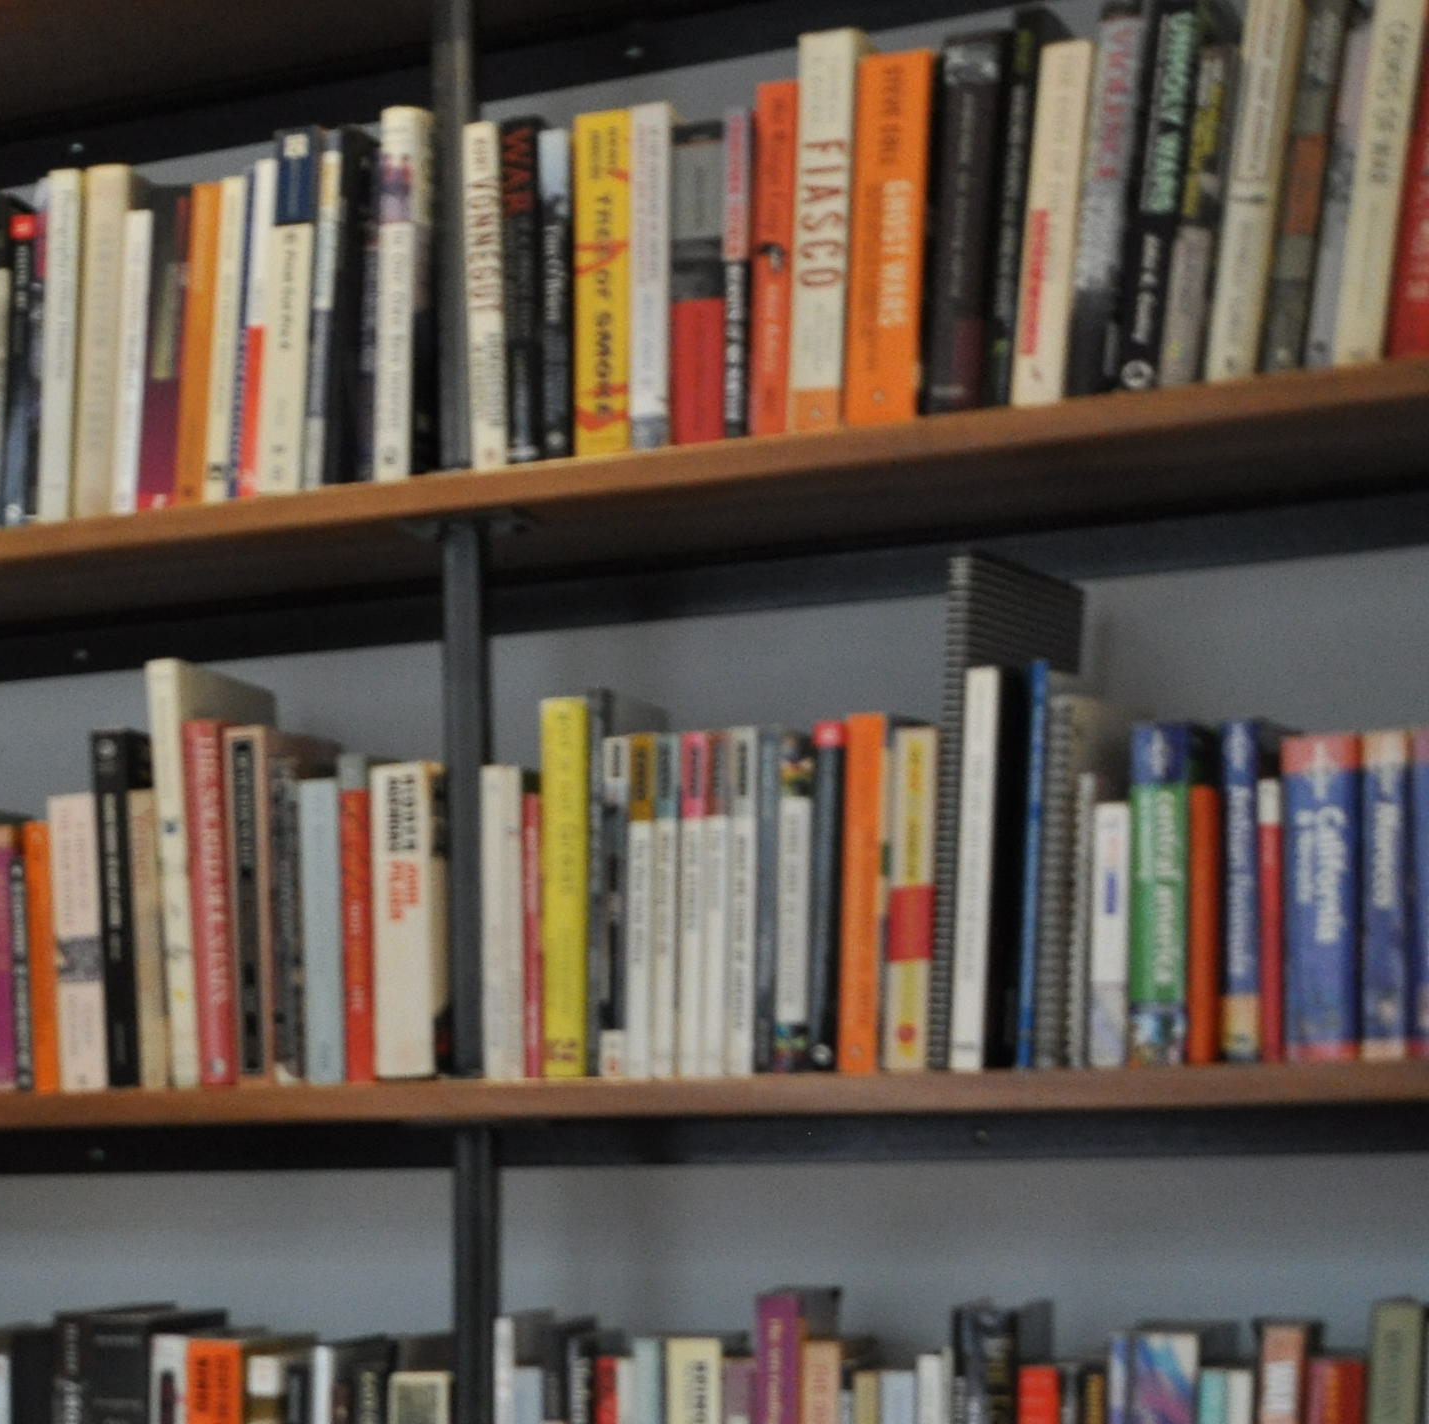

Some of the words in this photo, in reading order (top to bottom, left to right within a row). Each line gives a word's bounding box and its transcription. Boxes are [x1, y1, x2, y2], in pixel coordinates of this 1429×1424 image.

[1159, 13, 1195, 126] UNHOLY
[503, 126, 534, 218] WAR
[799, 138, 847, 292] FIASCO
[879, 179, 914, 258] GHOST
[1146, 130, 1182, 215] WARS
[466, 175, 502, 313] VONNEGUT
[876, 260, 910, 329] WARS
[1154, 790, 1182, 880] central
[1314, 805, 1348, 946] California
[1372, 801, 1398, 909] Morocco
[1153, 884, 1179, 985] america
